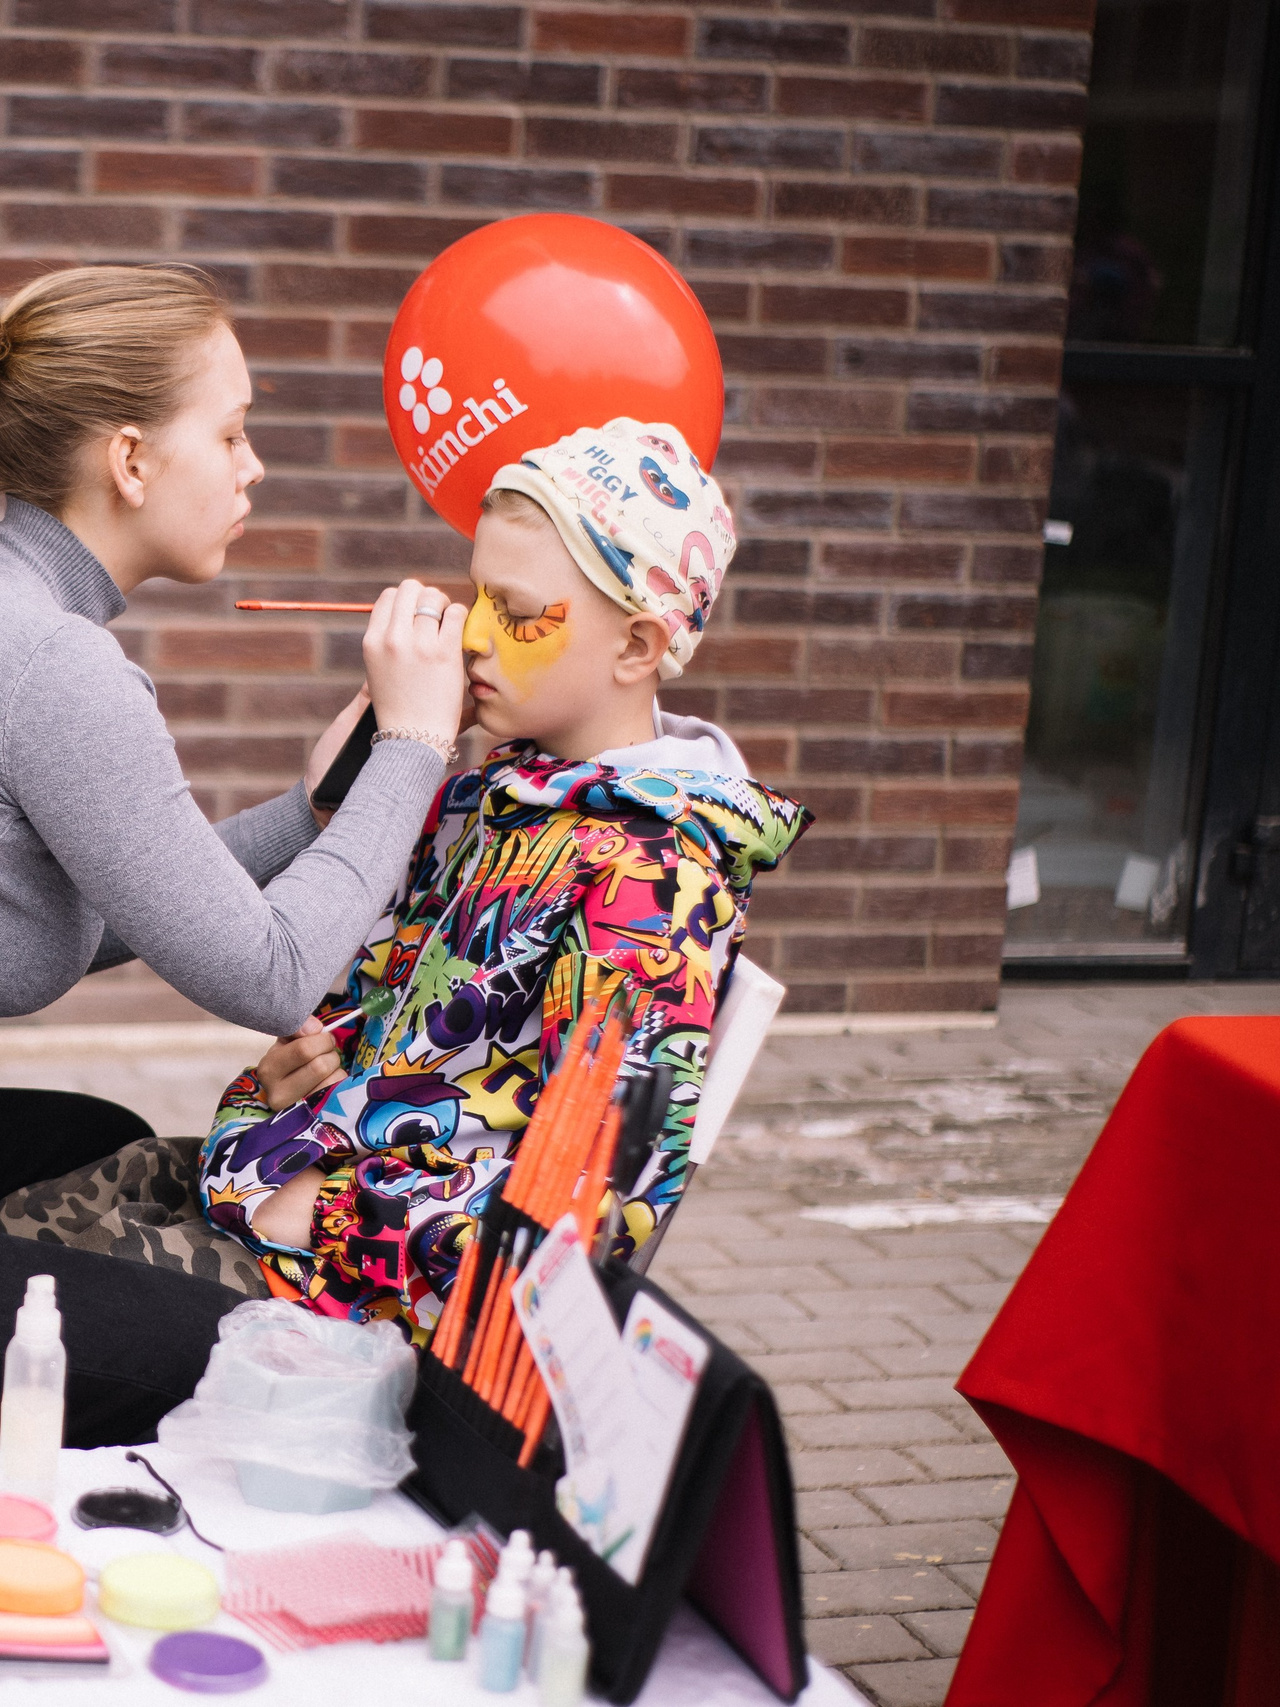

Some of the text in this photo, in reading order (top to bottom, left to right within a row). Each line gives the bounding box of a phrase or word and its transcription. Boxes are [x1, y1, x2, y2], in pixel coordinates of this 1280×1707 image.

[409, 378, 529, 499] kimchi
[583, 445, 616, 466] HU
[586, 464, 639, 503] GGY
